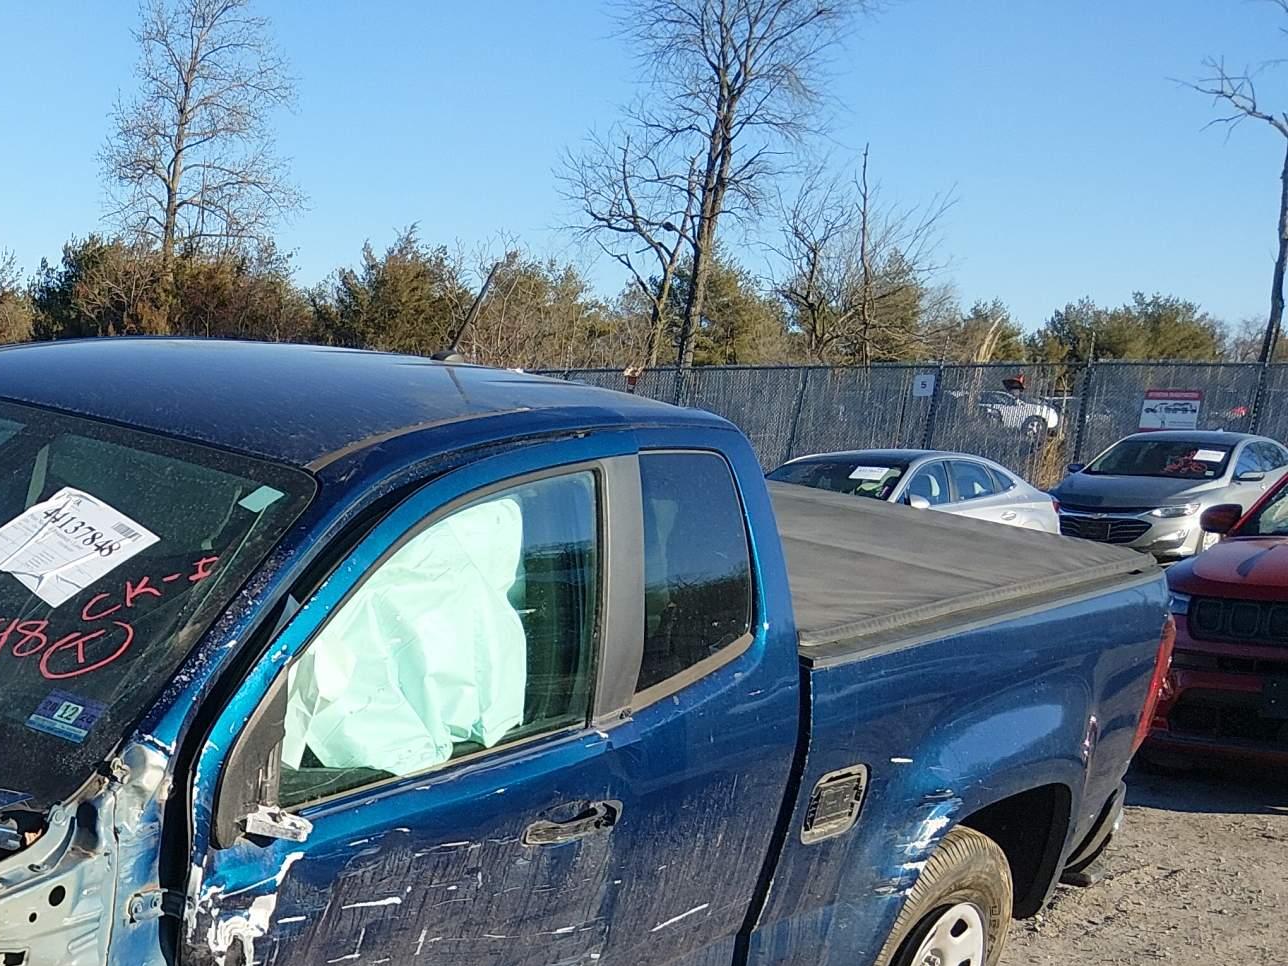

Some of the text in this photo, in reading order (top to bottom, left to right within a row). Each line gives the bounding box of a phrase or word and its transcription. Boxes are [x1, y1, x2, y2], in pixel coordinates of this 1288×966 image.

[920, 381, 928, 389] 5
[43, 507, 122, 558] 44137848
[56, 704, 80, 721] 12
